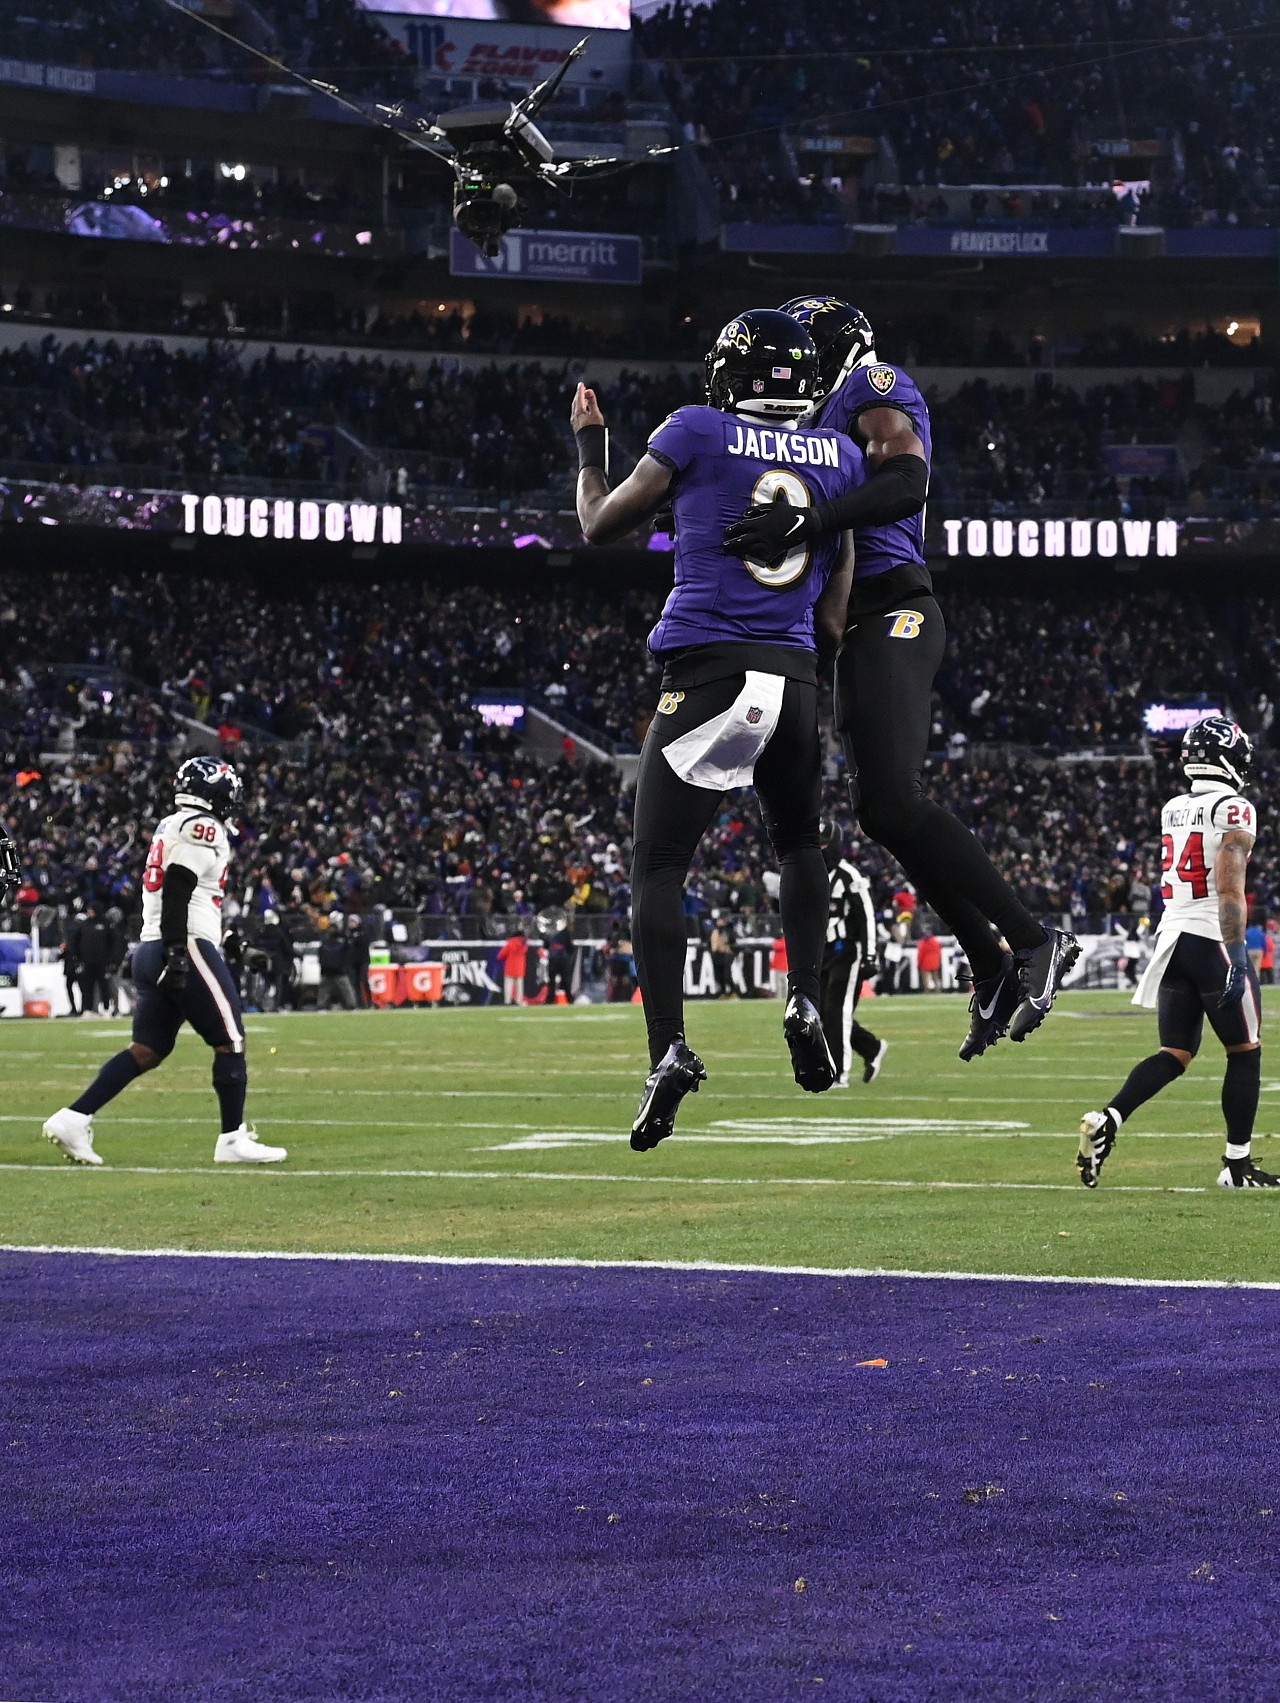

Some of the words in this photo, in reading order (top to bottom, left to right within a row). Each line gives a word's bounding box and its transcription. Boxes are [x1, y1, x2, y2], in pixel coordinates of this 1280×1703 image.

[528, 240, 618, 265] merritt
[797, 379, 806, 394] 8
[728, 426, 839, 467] JACKSON
[181, 494, 402, 544] TOUCHDOWN
[944, 519, 1177, 557] TOUCHDOWN
[884, 610, 925, 639] B
[1228, 805, 1251, 825] 24
[193, 823, 216, 843] 98
[413, 971, 433, 992] G
